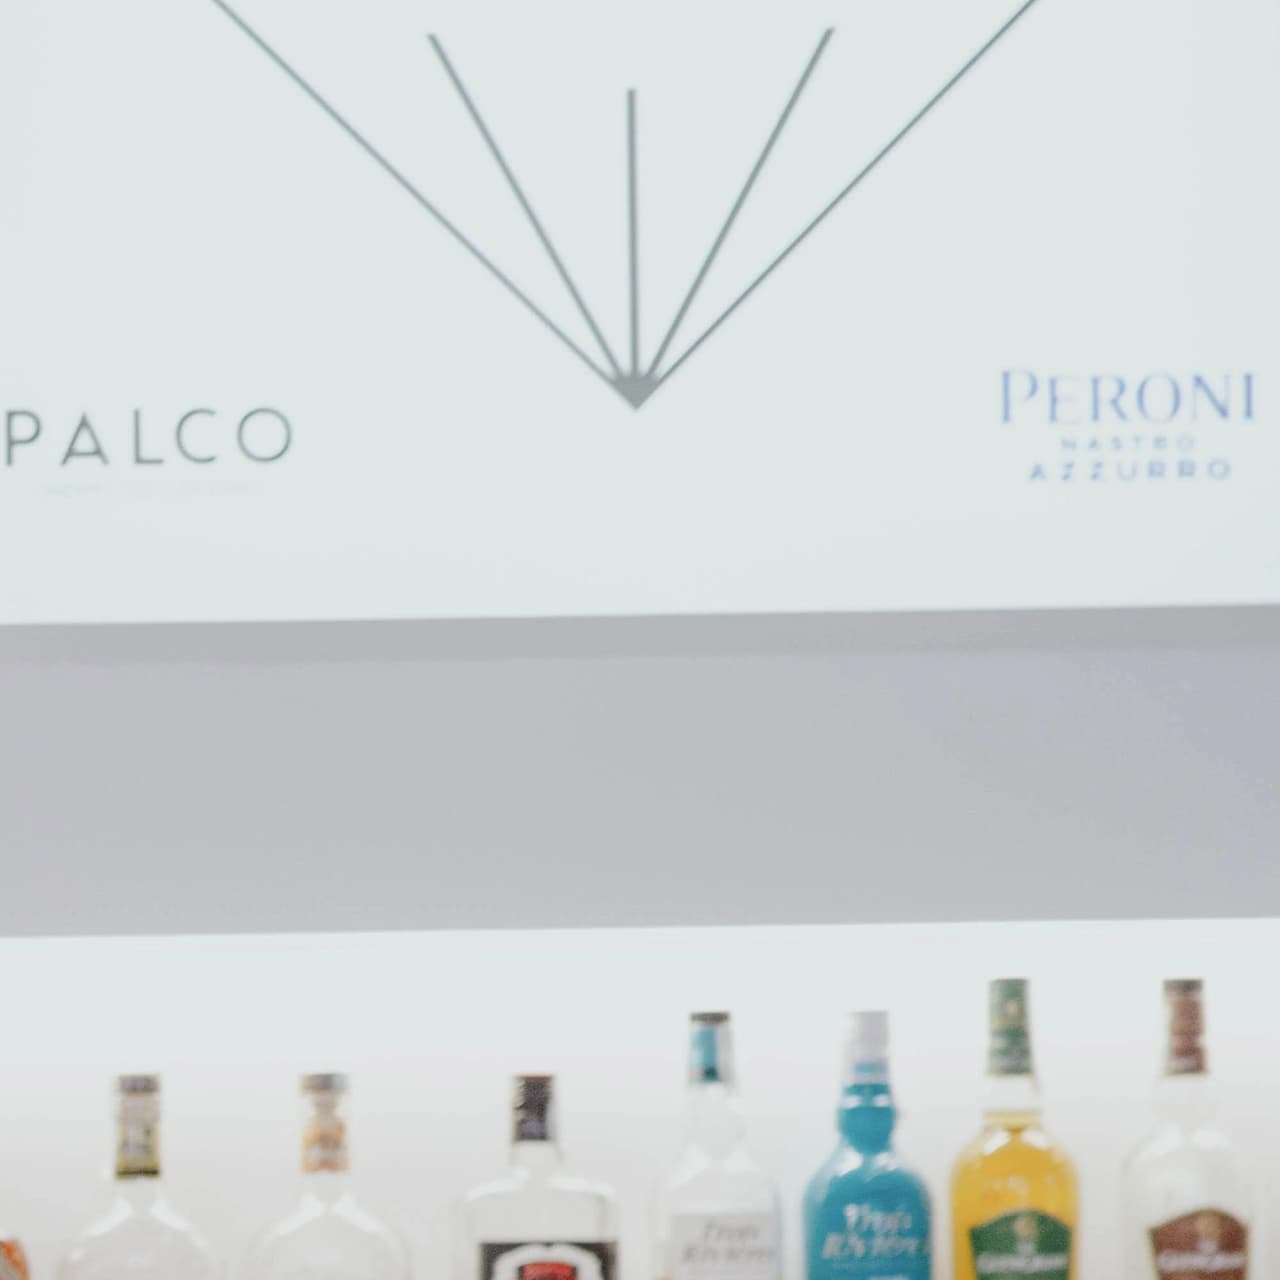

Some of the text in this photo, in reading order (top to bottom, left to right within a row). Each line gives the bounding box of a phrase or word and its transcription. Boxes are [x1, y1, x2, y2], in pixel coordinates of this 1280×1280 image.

[1000, 369, 1255, 425] PERONI
[5, 407, 292, 466] PALCO
[1028, 458, 1233, 483] AZZURRO
